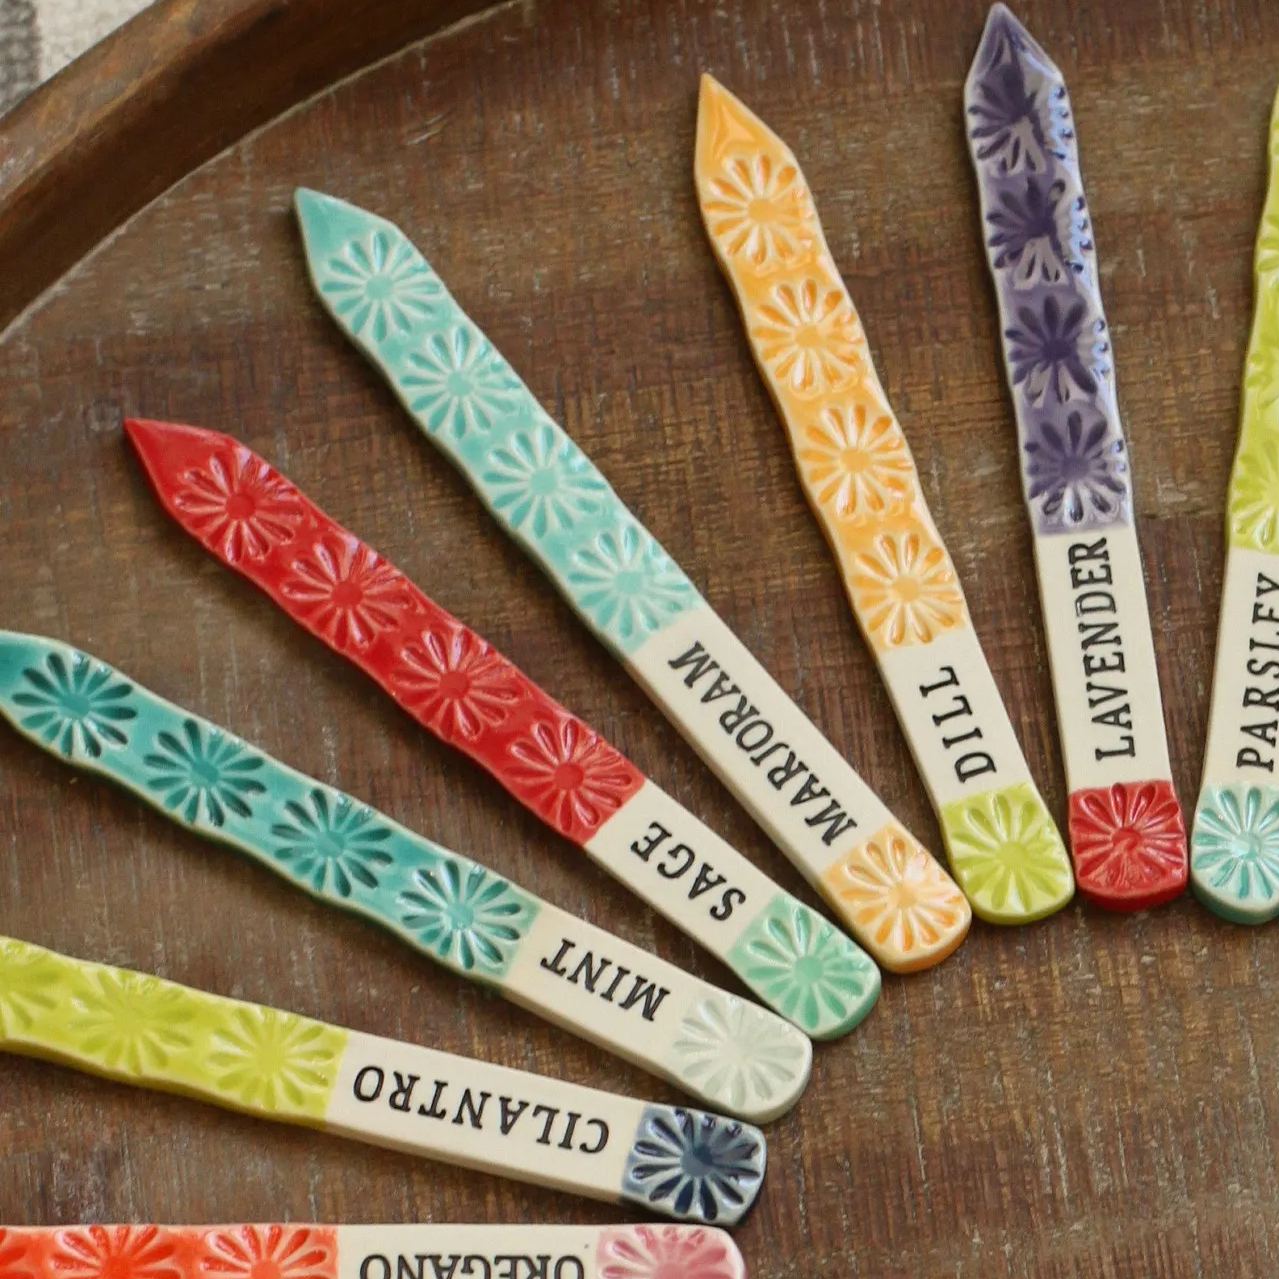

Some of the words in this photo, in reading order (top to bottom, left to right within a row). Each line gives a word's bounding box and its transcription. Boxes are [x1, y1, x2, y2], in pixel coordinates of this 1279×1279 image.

[1067, 537, 1136, 761] LAVENDER
[668, 641, 858, 846] MARJORAM
[919, 666, 997, 784] DILL
[630, 821, 746, 921] SAGE
[540, 938, 671, 1022] MINT
[353, 1065, 610, 1154] CILANTRO
